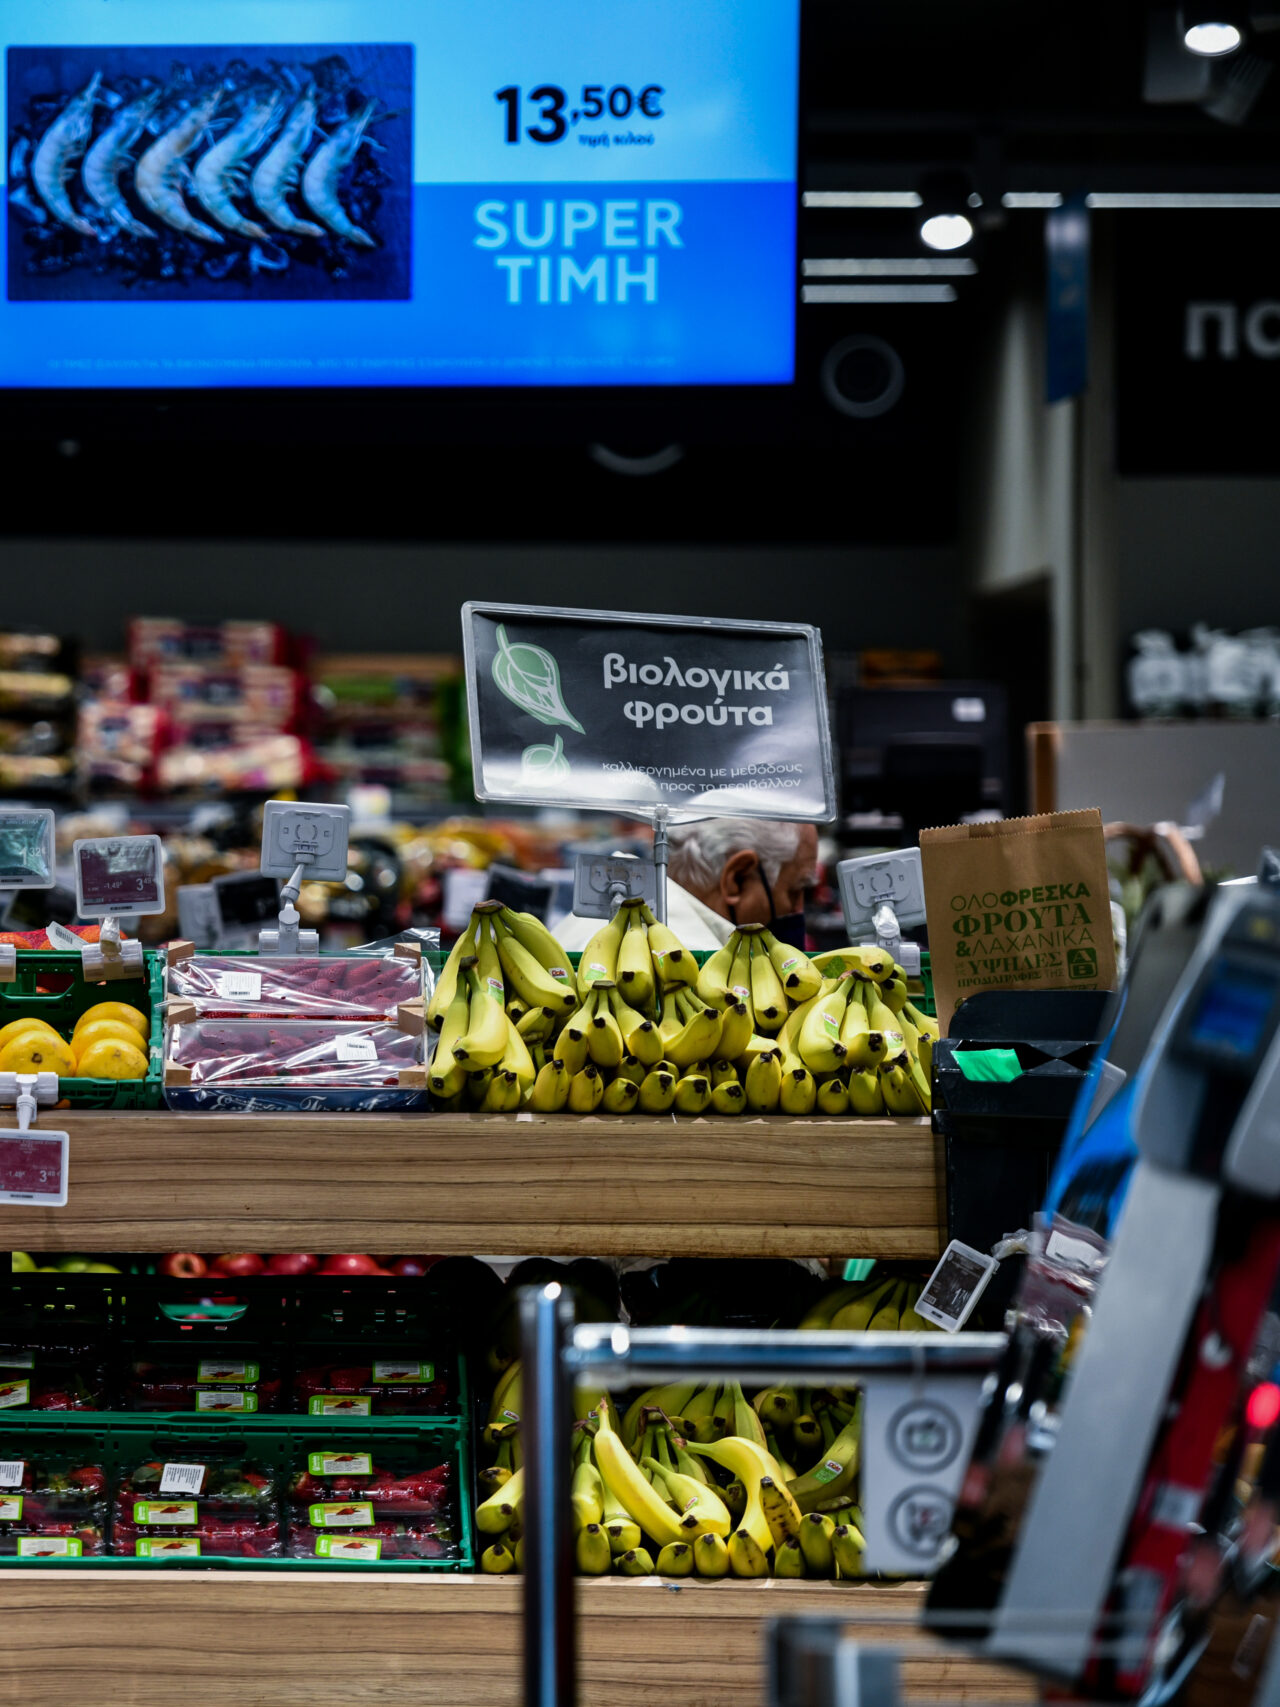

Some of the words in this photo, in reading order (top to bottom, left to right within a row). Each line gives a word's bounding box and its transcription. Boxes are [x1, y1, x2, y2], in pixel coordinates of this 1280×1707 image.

[495, 84, 664, 145] 13,50€
[474, 200, 684, 249] SUPER
[496, 255, 658, 304] ΤΙΜΗ
[603, 653, 790, 696] βιολογικά
[623, 697, 773, 730] φρούτα
[602, 760, 706, 777] καλλιεργημένα
[710, 766, 727, 778] με
[731, 762, 803, 778] μεθόδους
[660, 779, 696, 793] προς
[699, 781, 715, 792] το
[718, 777, 801, 793] περιβάλλον
[950, 882, 1091, 911] ΟΛΟΦΡΕΣΚΑ
[953, 902, 1093, 938] ΦΡΟΥΤΑ
[968, 952, 1062, 975] ΥΨΗΛΕΣ
